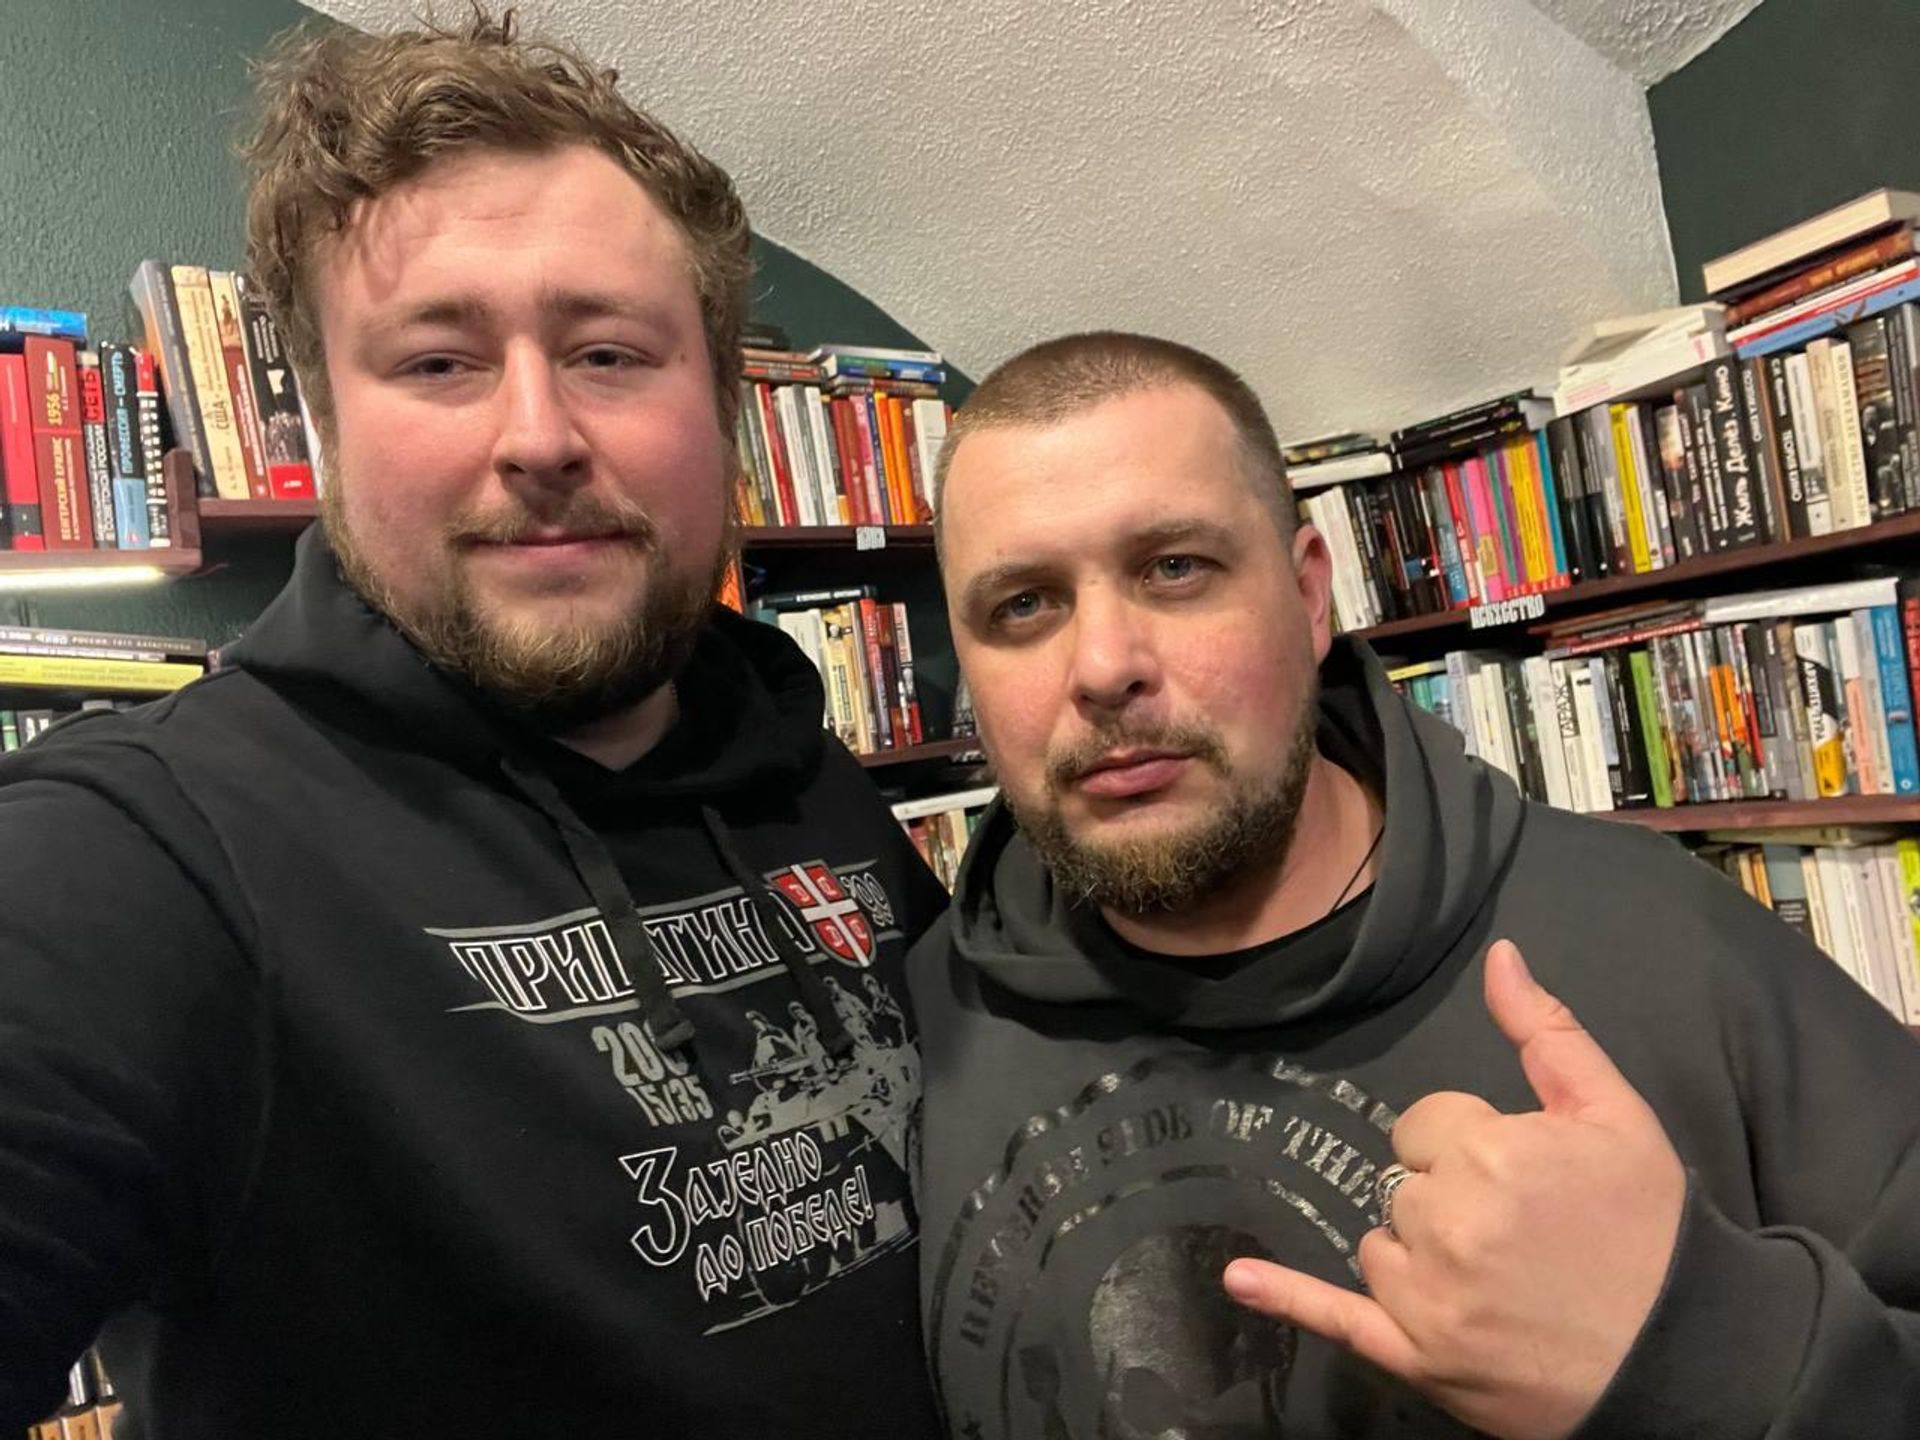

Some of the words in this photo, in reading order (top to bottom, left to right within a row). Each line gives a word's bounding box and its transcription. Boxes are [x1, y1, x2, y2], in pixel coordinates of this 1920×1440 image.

[47, 391, 63, 426] 1956
[213, 399, 230, 430] США
[1715, 365, 1734, 413] Кино
[625, 1074, 715, 1128] 15/35
[1097, 1103, 1193, 1166] SIDE
[1208, 1098, 1275, 1143] OF
[1281, 1115, 1378, 1209] THE
[695, 1233, 744, 1302] ДО
